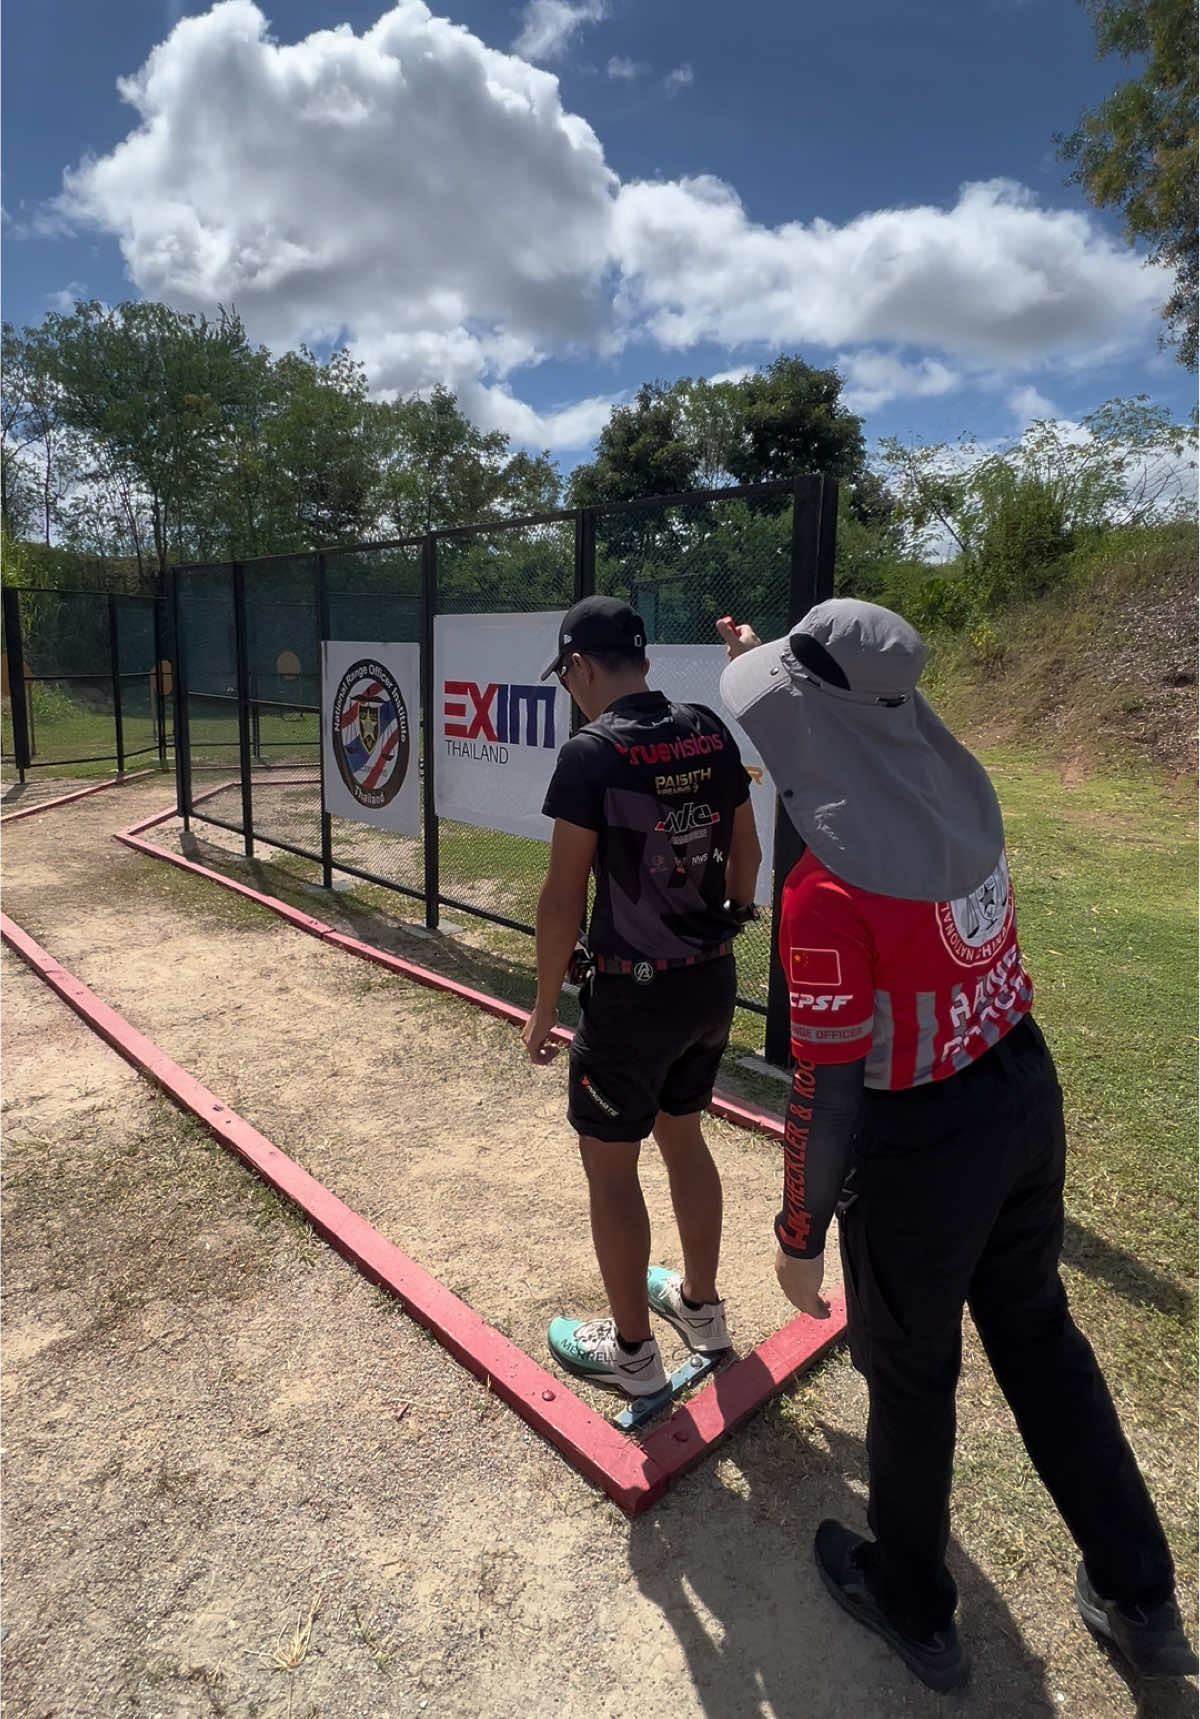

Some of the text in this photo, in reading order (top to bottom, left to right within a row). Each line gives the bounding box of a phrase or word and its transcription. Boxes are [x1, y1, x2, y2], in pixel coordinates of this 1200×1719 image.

[334, 681, 348, 732] National
[345, 665, 368, 687] Range
[369, 664, 393, 689] Officer
[444, 681, 557, 749] EXIM
[445, 740, 509, 764] THAILAND
[354, 785, 385, 804] Thailand
[789, 1103, 813, 1122] &
[784, 1119, 811, 1210] HECKLER
[560, 1339, 617, 1362] MERRELL
